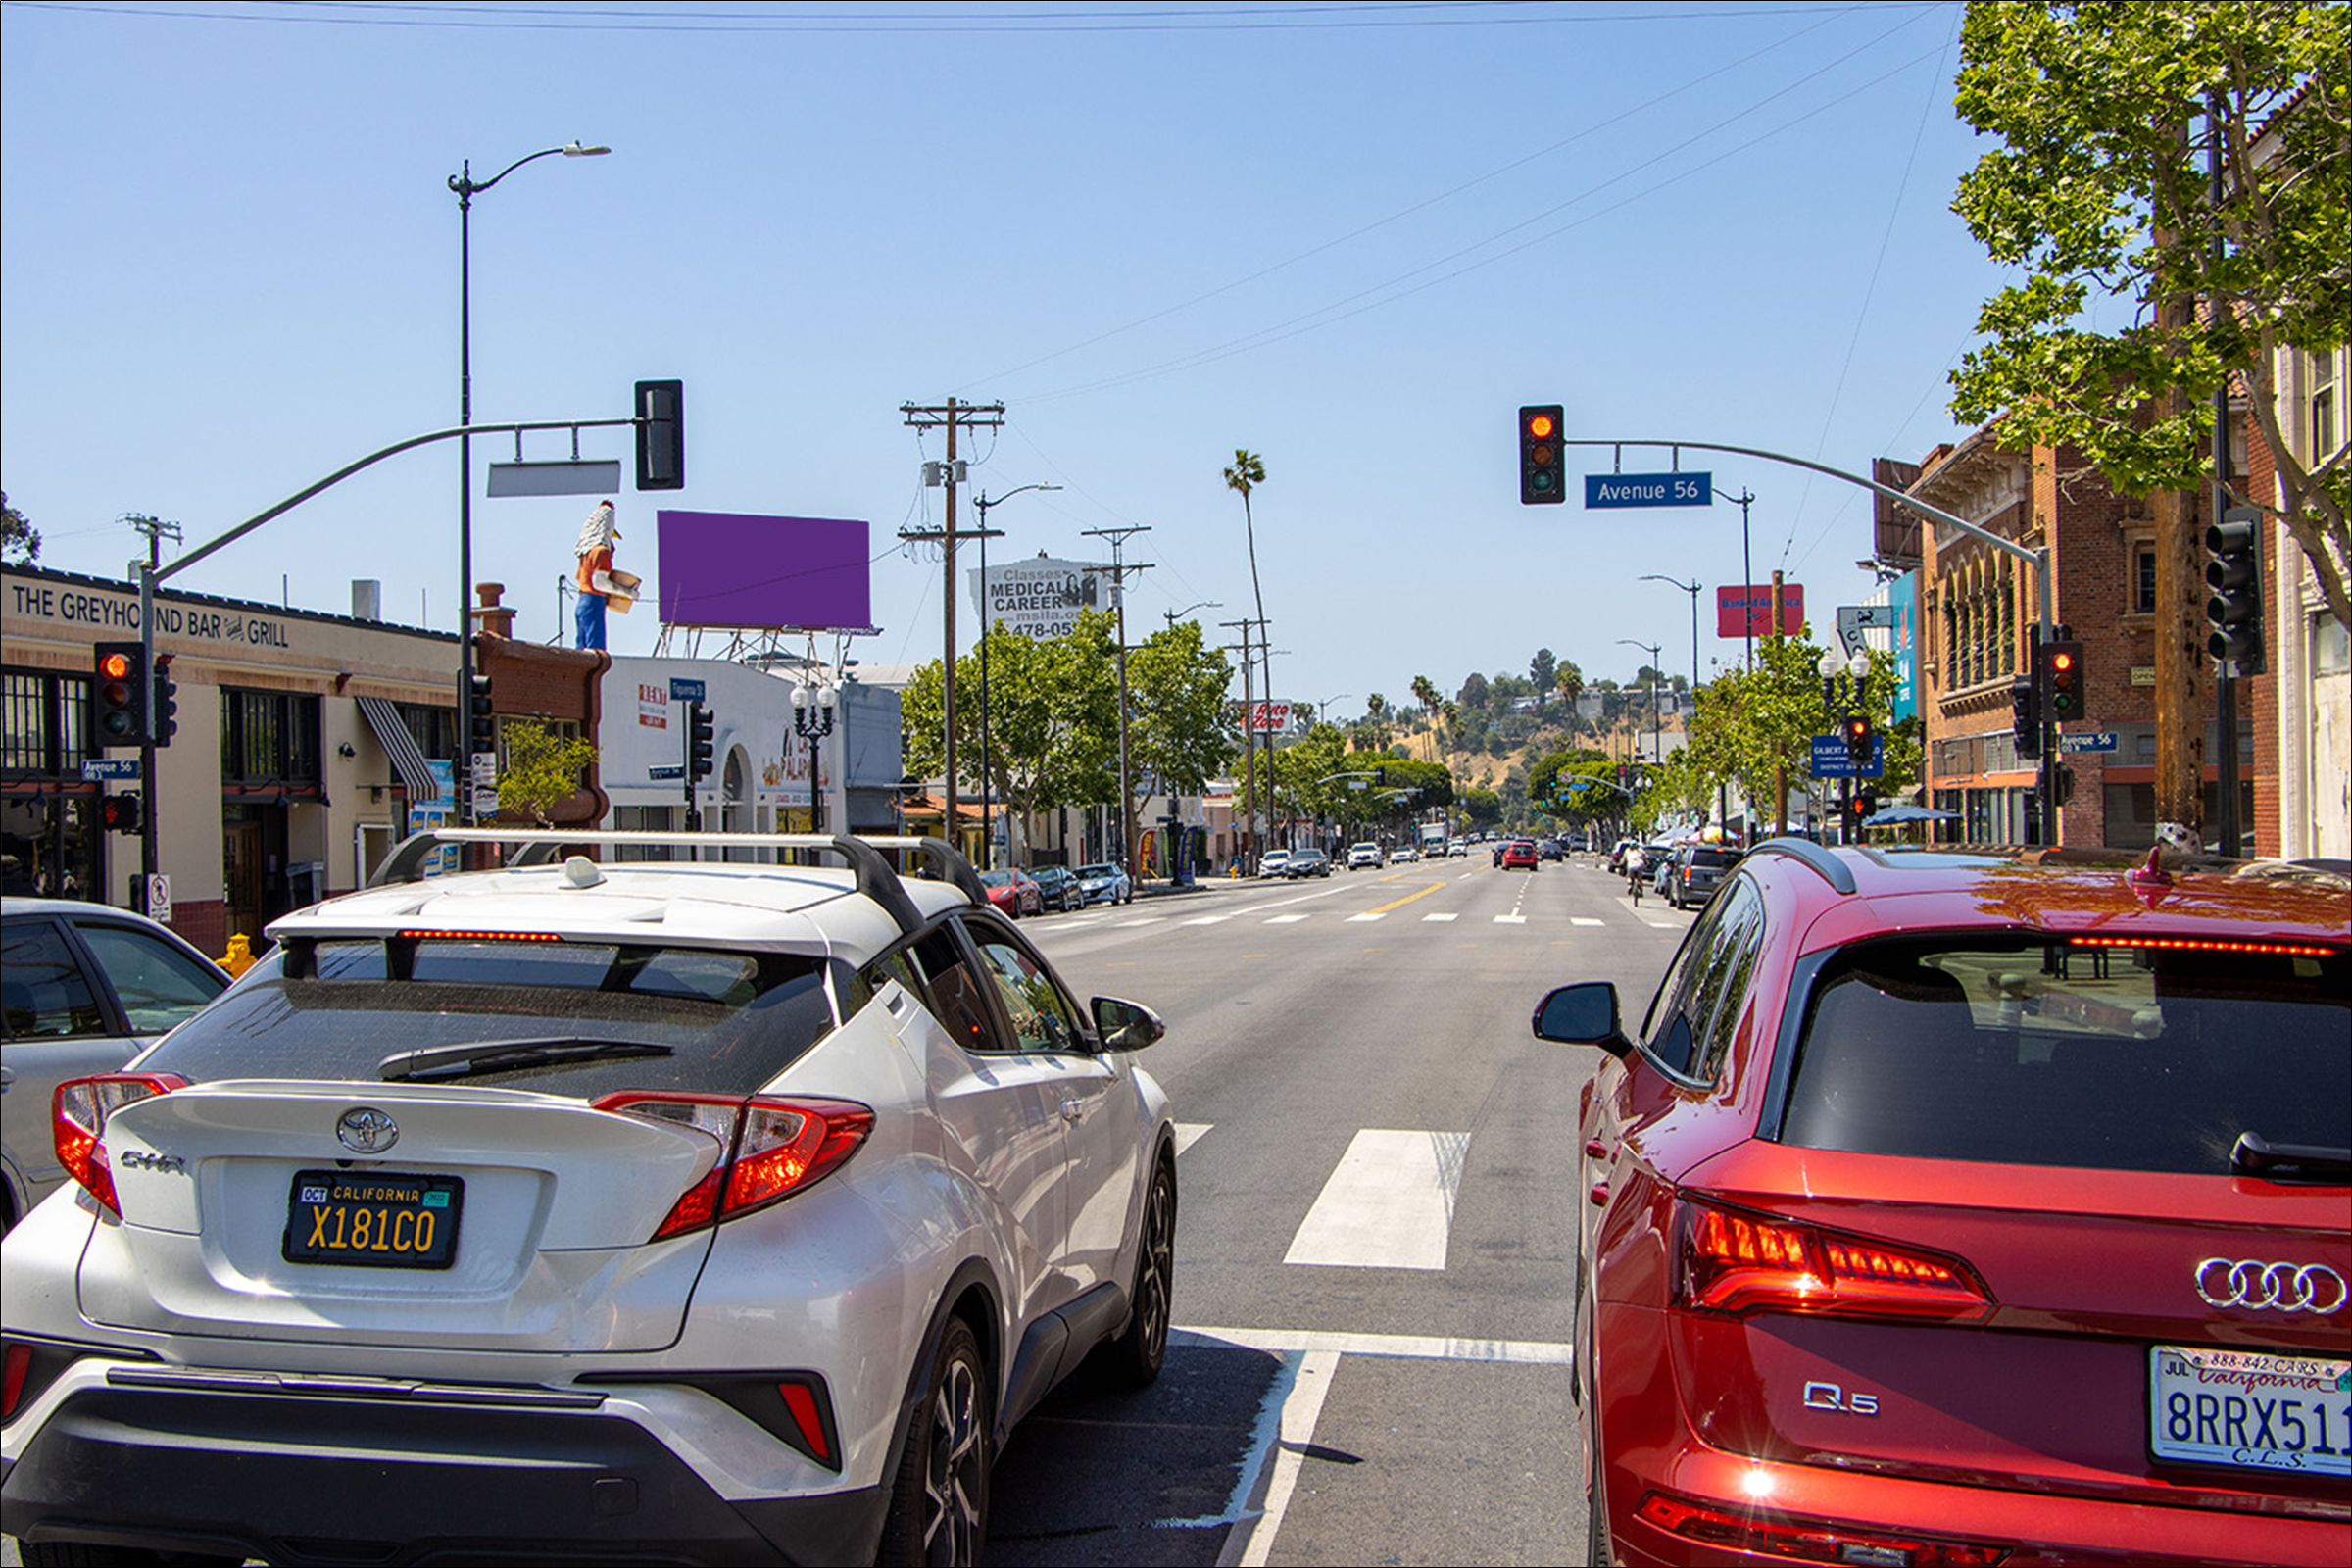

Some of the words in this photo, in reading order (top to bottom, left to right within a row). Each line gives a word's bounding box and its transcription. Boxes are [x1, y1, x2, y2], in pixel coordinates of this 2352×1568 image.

[1598, 483, 1665, 500] Avenue
[1674, 481, 1698, 498] 56
[1004, 569, 1062, 581] Classes
[991, 581, 1064, 597] MEDICAL
[995, 596, 1063, 612] CAREER
[1721, 598, 1747, 608] Bank
[1759, 597, 1800, 607] Amica
[13, 586, 53, 616] THE
[61, 593, 182, 633] GREYHOND
[188, 612, 220, 639] BAR
[225, 616, 244, 641] and
[248, 620, 288, 648] GRILL
[2061, 736, 2094, 745] Avenue
[2098, 733, 2111, 745] 56
[85, 761, 116, 773] Avenue
[120, 760, 132, 772] 56
[305, 1189, 325, 1200] OCT
[333, 1186, 419, 1202] CALIFORNIA
[2165, 1361, 2190, 1377] JUL
[1804, 1381, 1879, 1414] Q5
